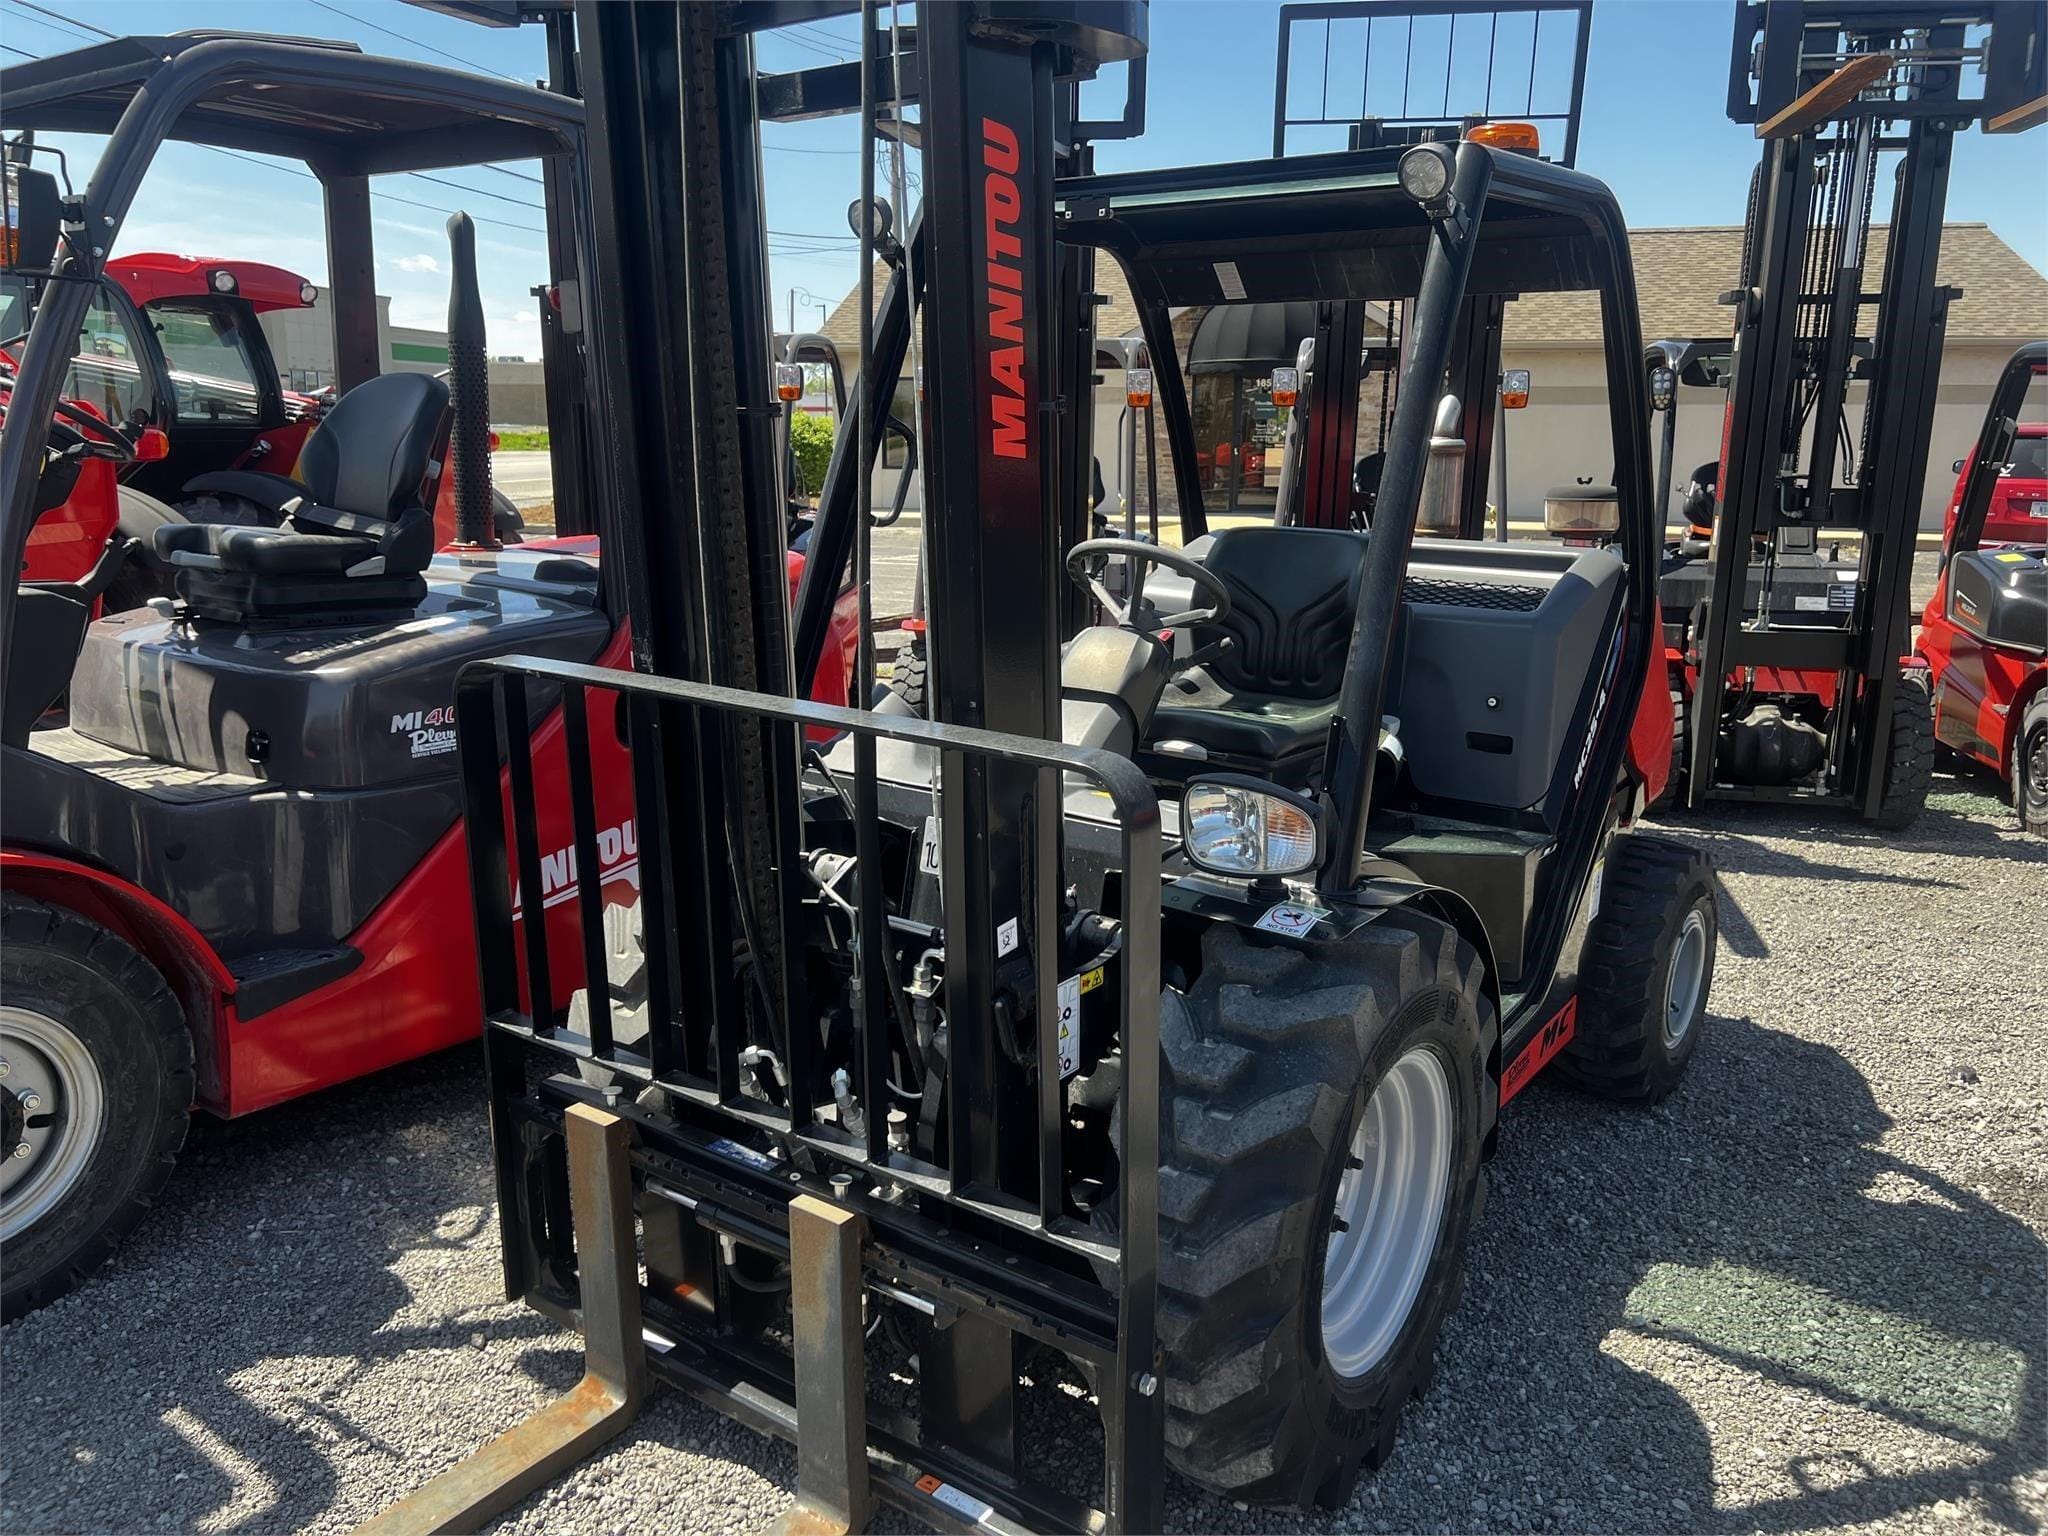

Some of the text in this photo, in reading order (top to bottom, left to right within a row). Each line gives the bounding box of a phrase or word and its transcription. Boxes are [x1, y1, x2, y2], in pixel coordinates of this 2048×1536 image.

[982, 117, 1027, 459] MANITOU
[390, 710, 423, 734] MI
[1280, 926, 1300, 934] STEP
